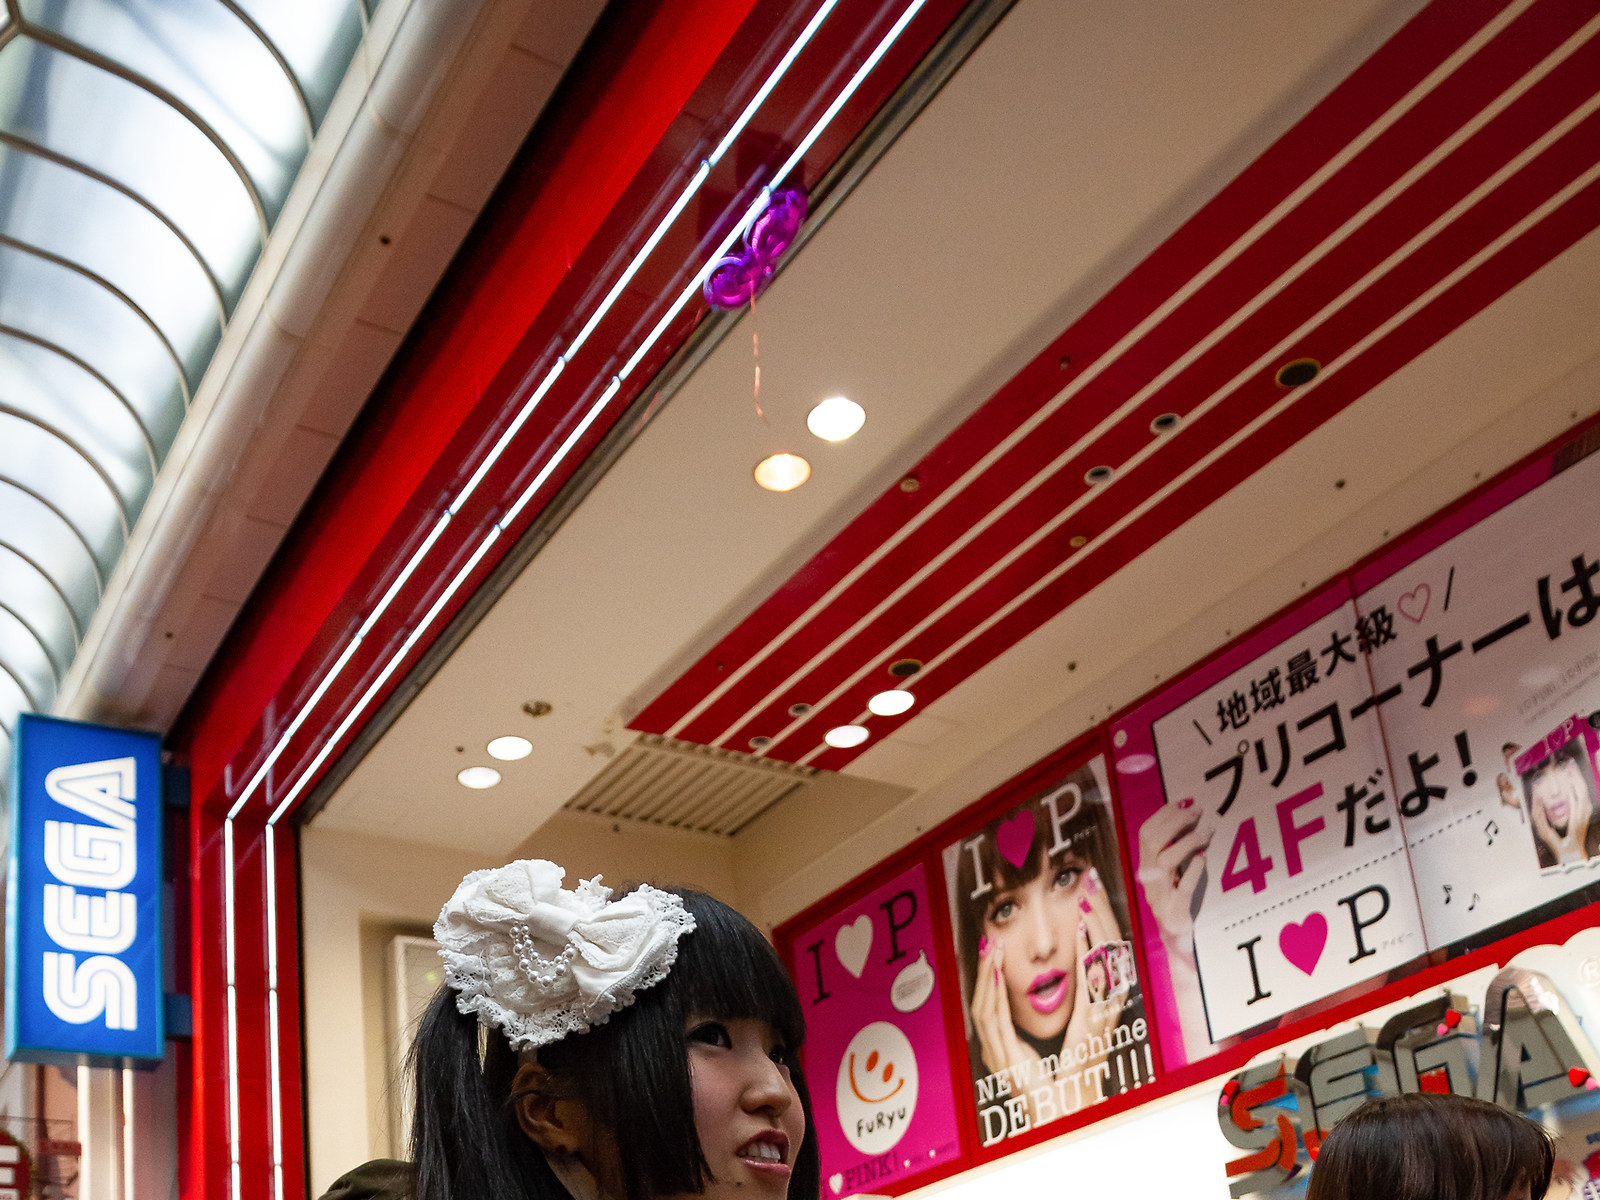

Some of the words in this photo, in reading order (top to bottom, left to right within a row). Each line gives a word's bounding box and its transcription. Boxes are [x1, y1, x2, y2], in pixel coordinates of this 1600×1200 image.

[1204, 553, 1600, 816] プリコーナーは
[1216, 604, 1397, 733] 地域最大級
[1040, 782, 1083, 857] P
[43, 756, 138, 1031] SEGA
[879, 889, 917, 965] P
[1337, 884, 1390, 964] P
[975, 1063, 1033, 1106] NEW
[1037, 1017, 1148, 1077] machine
[844, 1151, 899, 1191] PINK!
